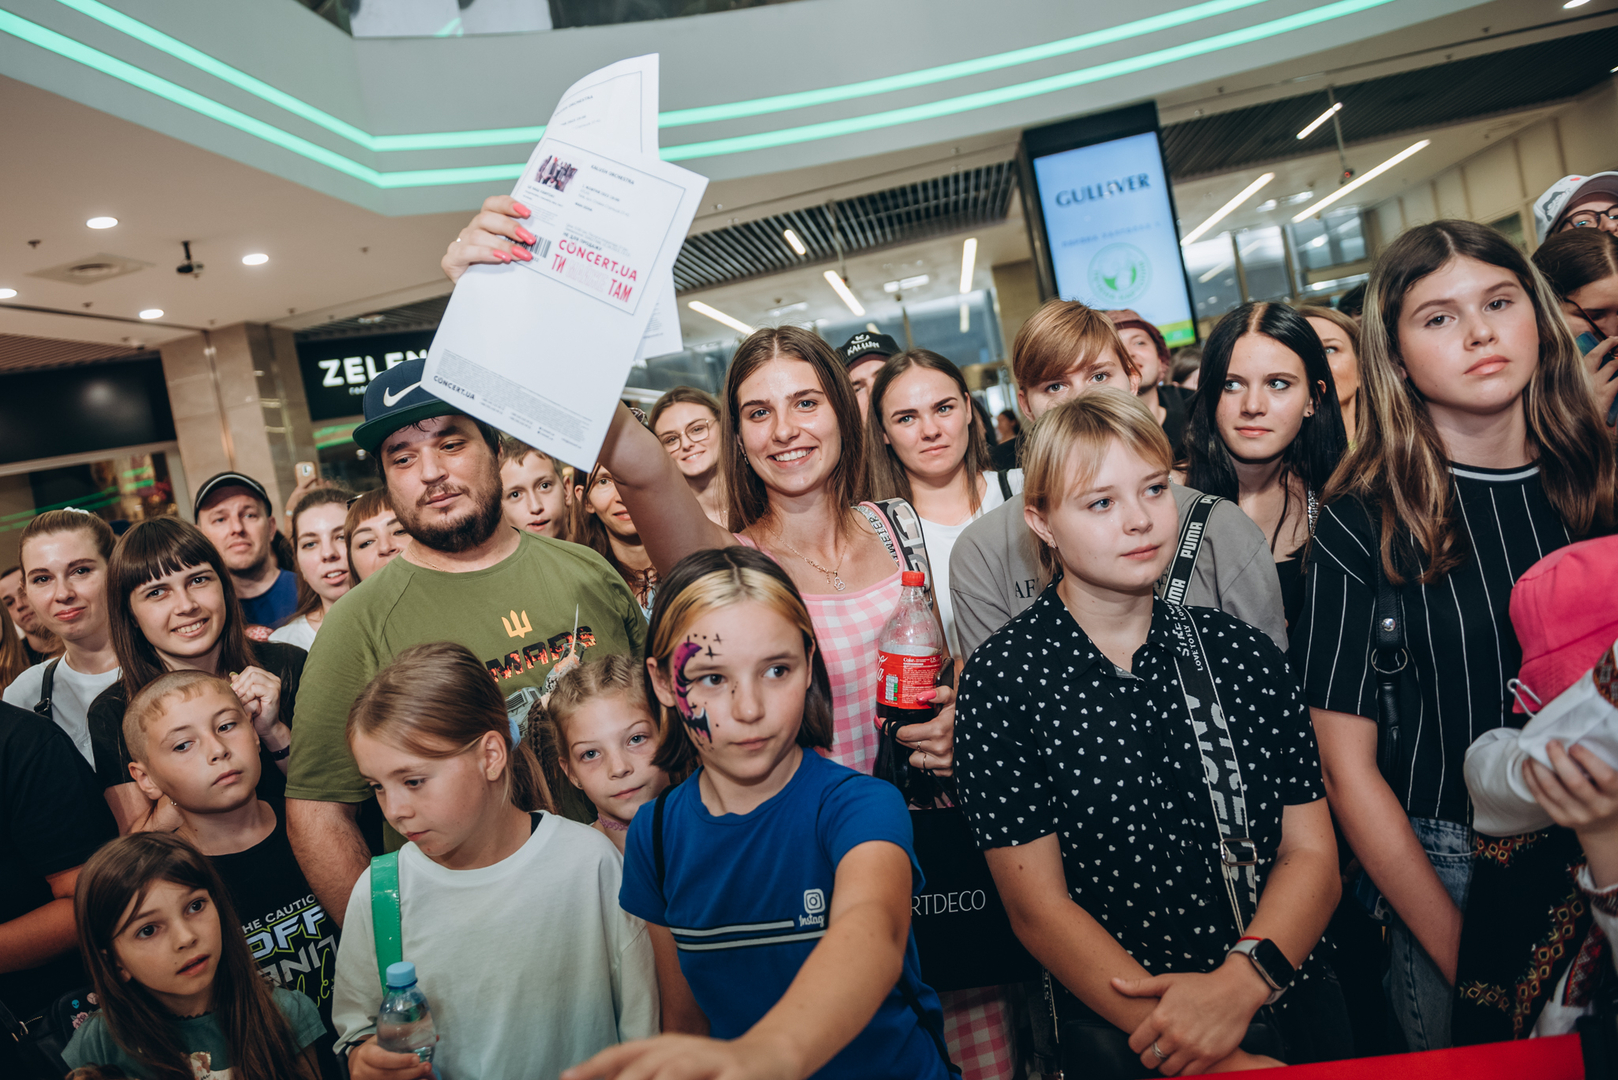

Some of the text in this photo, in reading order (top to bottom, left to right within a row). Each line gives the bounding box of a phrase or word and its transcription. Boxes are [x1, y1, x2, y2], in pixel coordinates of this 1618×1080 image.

[608, 278, 633, 303] ТАМ
[1180, 521, 1203, 559] PUMA
[1182, 624, 1193, 637] FLY
[1188, 637, 1196, 649] TO
[1191, 649, 1204, 671] LOVE
